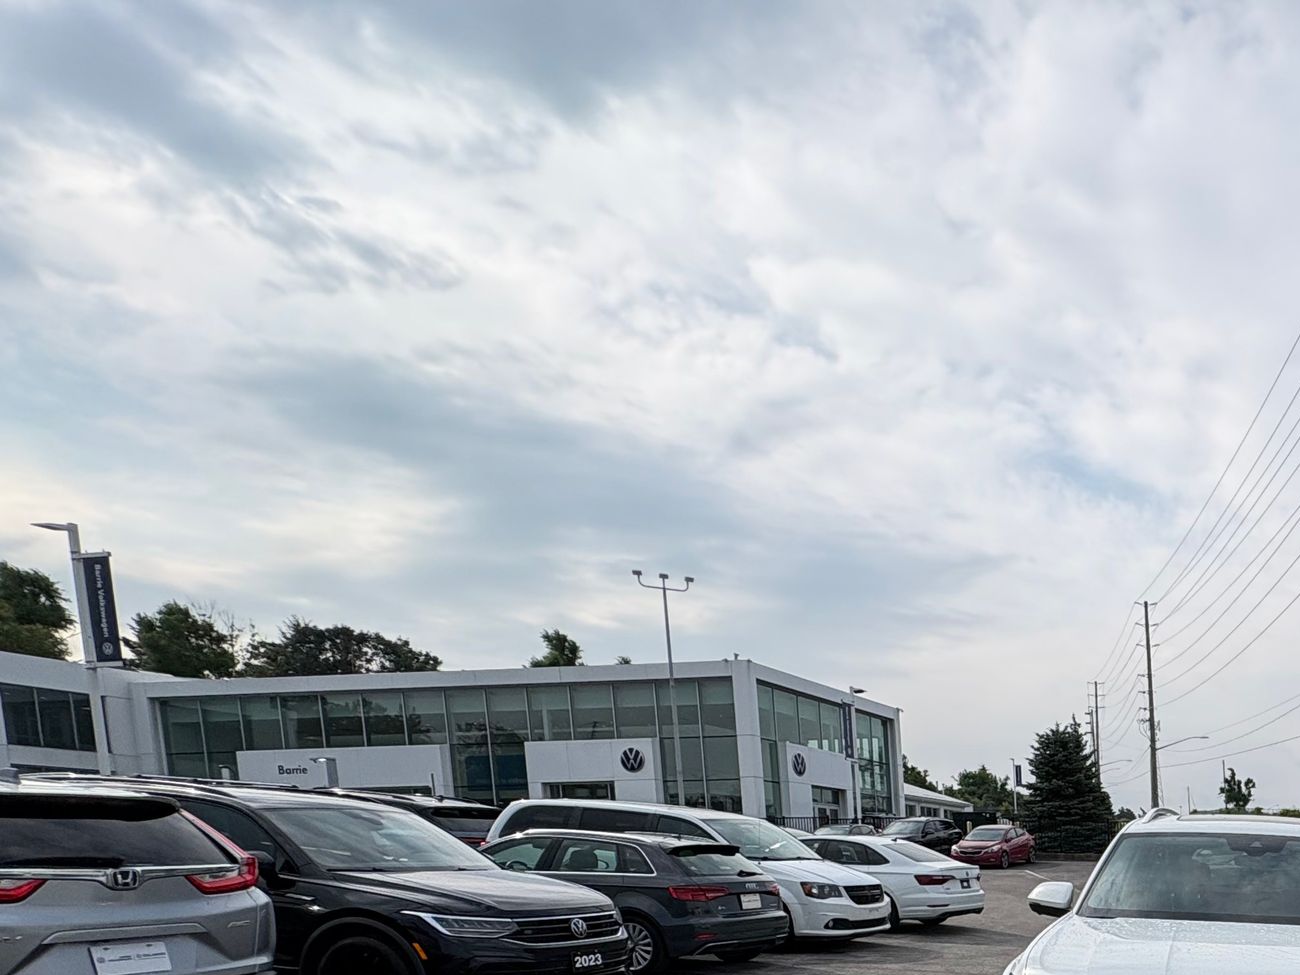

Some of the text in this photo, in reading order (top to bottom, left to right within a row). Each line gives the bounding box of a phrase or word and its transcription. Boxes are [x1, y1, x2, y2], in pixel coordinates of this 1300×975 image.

[94, 563, 109, 638] Barrie Volkswagen
[277, 765, 308, 775] Barrie
[574, 953, 602, 968] 2023
